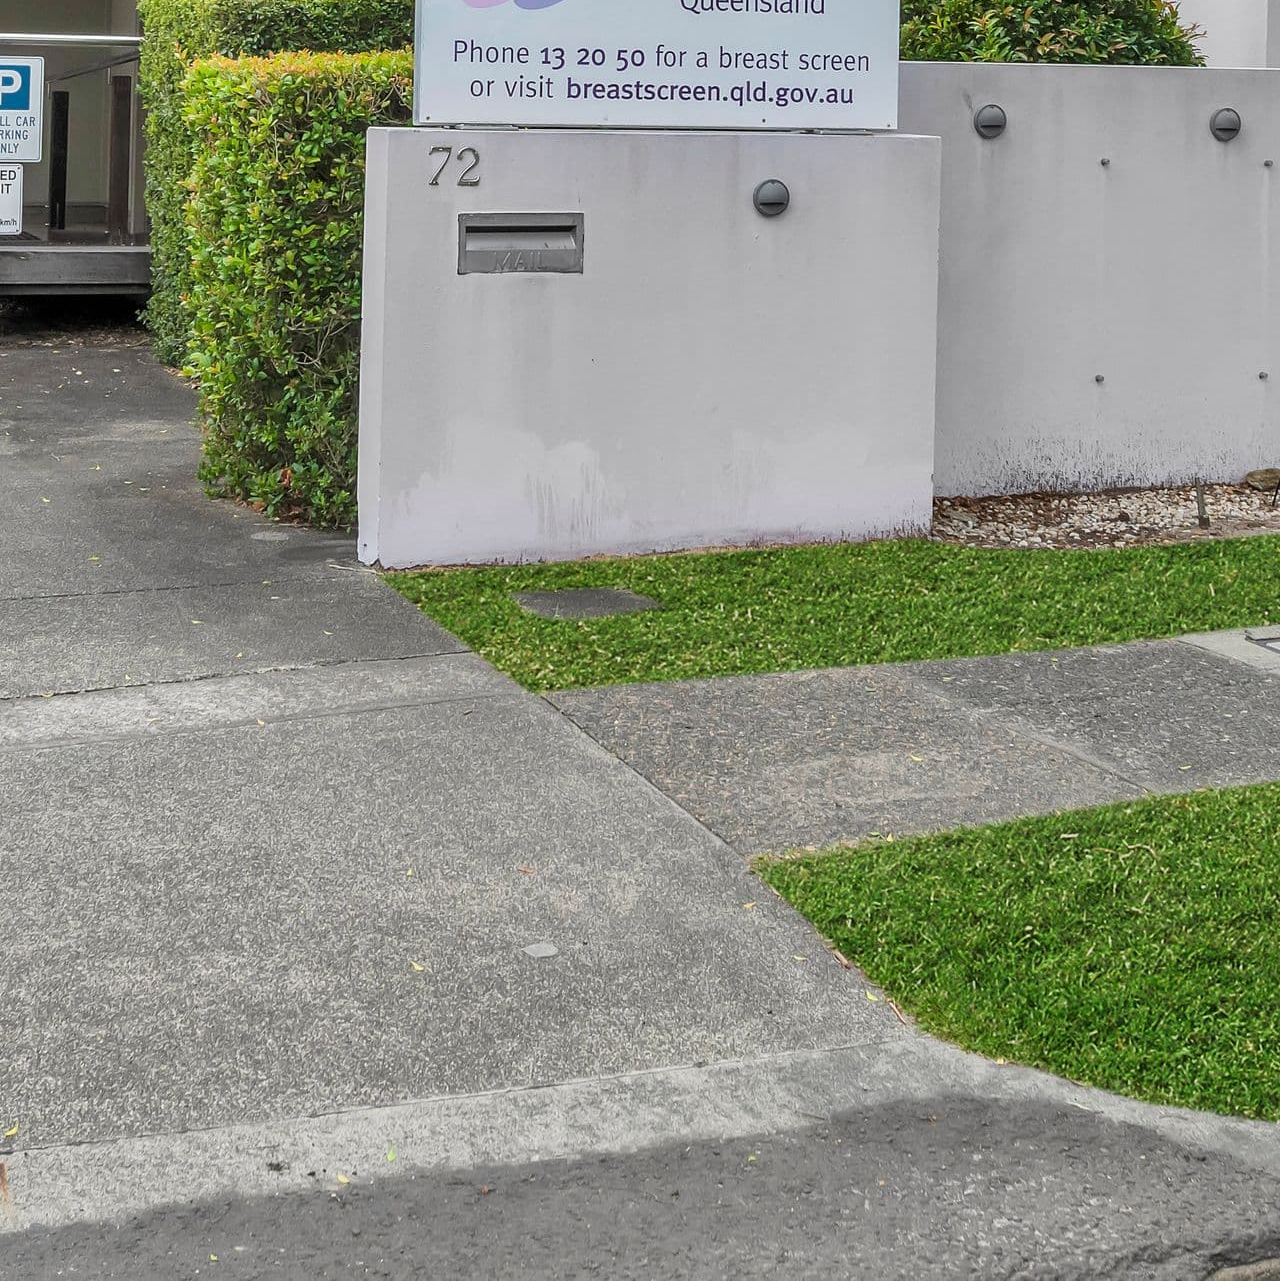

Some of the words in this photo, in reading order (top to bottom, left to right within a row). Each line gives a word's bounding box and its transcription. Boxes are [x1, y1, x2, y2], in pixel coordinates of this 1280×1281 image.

[453, 39, 529, 64] Phone
[540, 46, 565, 70] 13
[577, 48, 606, 66] 20
[616, 49, 645, 71] 50
[656, 44, 687, 67] for
[696, 50, 708, 68] a
[719, 45, 789, 70] breast
[798, 52, 870, 71] screen
[470, 79, 495, 97] or
[504, 75, 554, 98] visit
[567, 77, 854, 107] breastscreen.qld.gov.au
[15, 116, 36, 127] CAR
[428, 146, 481, 187] 72
[0, 218, 17, 226] km/h
[494, 251, 543, 272] MAIL
